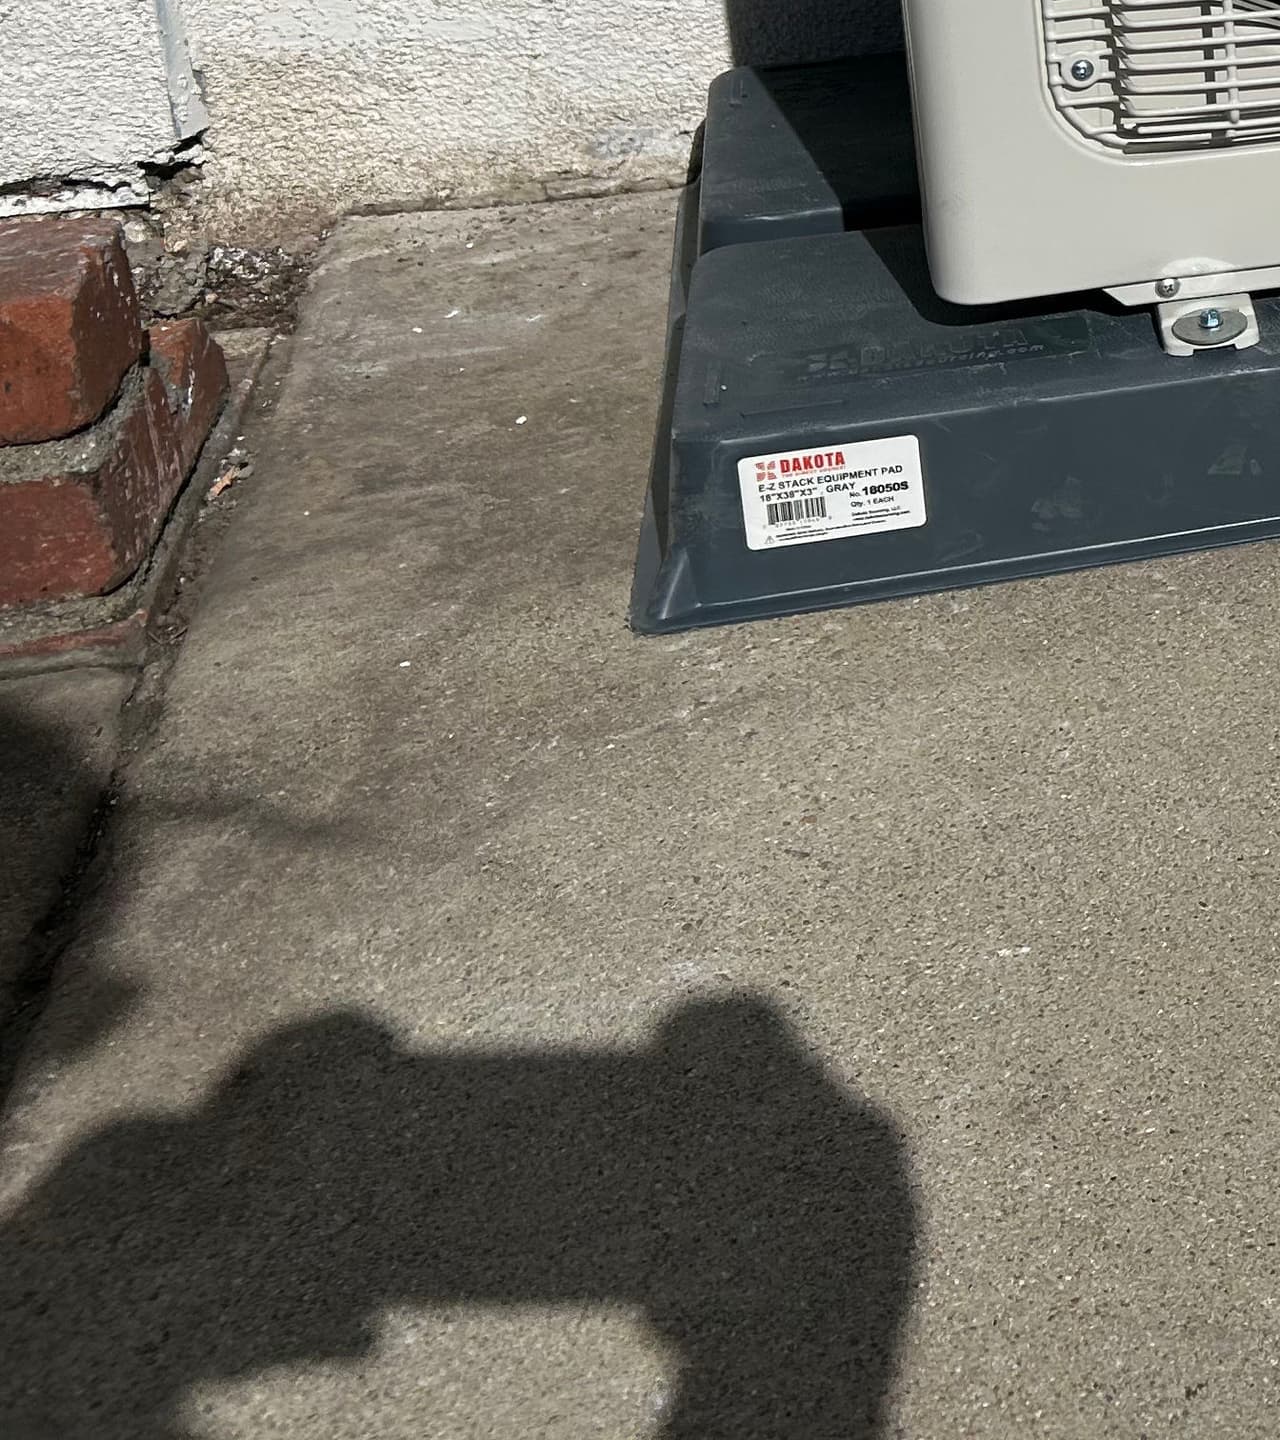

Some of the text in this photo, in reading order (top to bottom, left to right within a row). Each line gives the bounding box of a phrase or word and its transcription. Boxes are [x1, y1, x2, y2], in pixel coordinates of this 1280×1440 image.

[779, 451, 845, 474] DAKOTA
[758, 482, 776, 493] E-Z
[778, 477, 815, 490] STACK
[817, 468, 878, 485] EQUIPMENT
[880, 465, 903, 476] PAD
[826, 482, 856, 493] GRAY
[862, 480, 909, 496] 18050S
